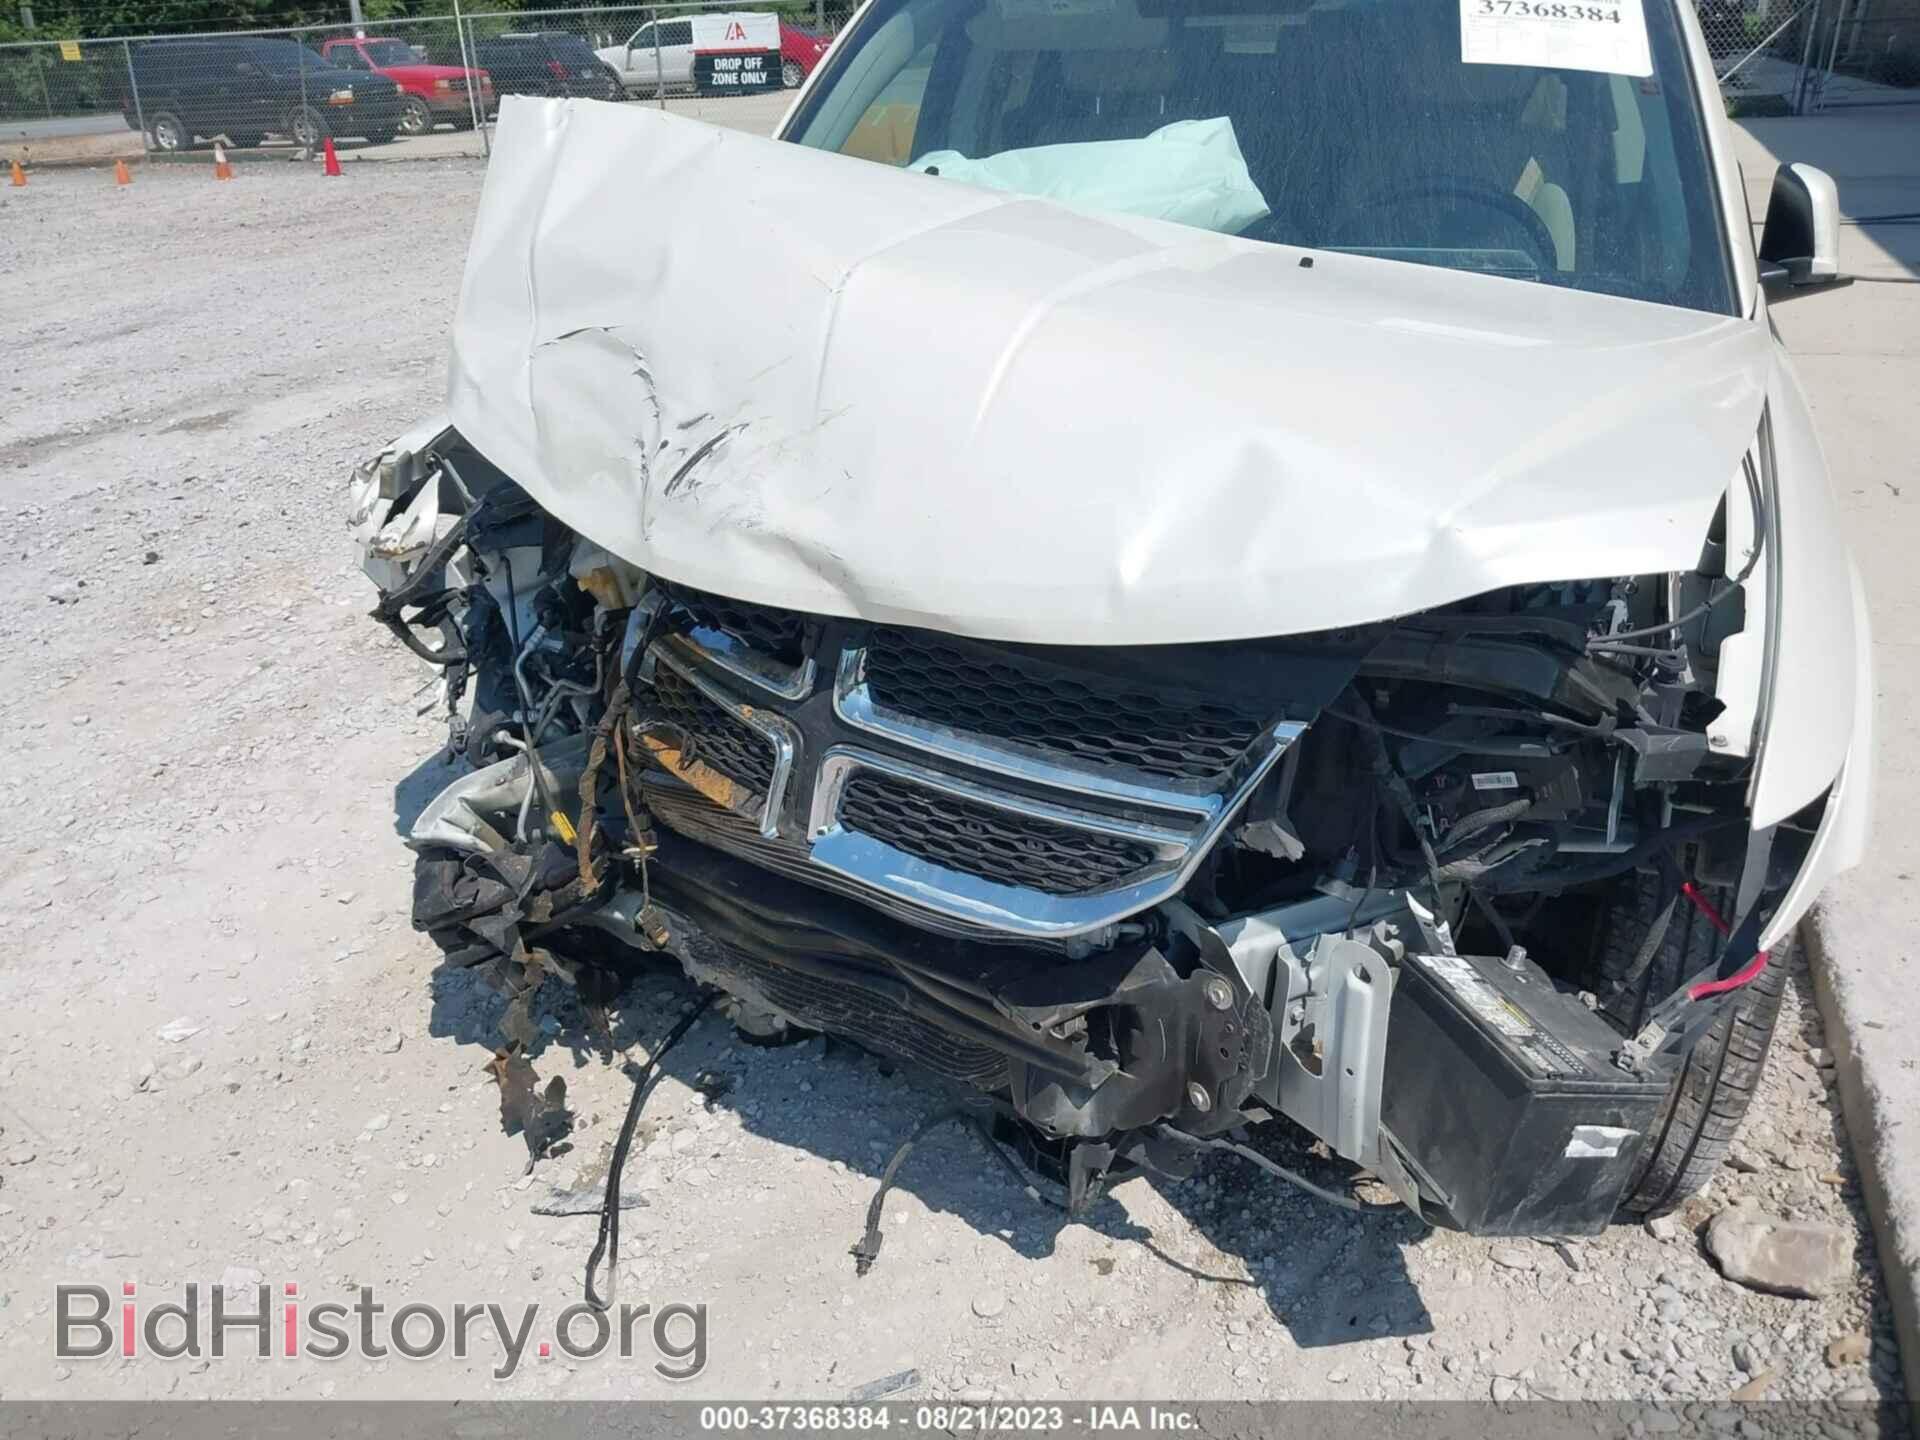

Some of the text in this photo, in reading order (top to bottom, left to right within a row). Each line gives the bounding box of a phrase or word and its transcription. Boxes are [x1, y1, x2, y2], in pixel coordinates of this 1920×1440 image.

[1478, 0, 1621, 23] 37368384
[714, 57, 763, 70] DROP OFF
[712, 71, 768, 85] ZONE ONLY
